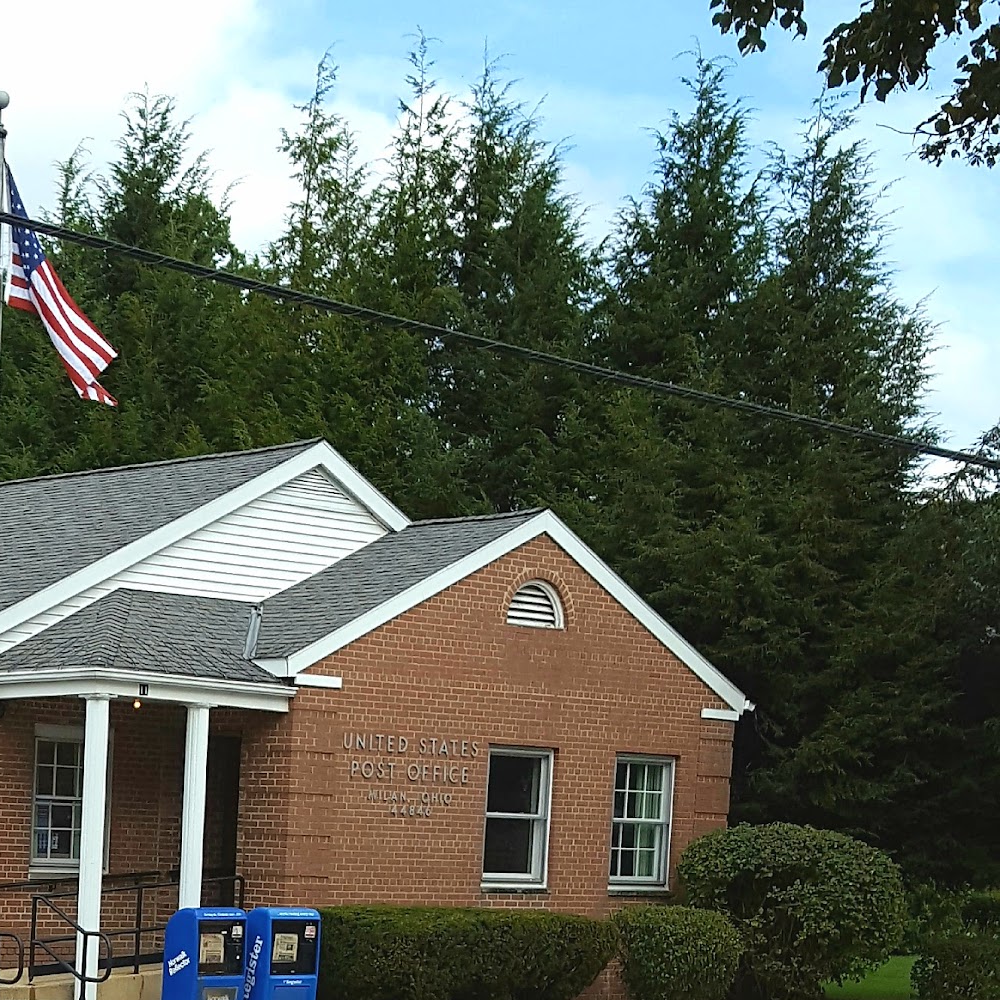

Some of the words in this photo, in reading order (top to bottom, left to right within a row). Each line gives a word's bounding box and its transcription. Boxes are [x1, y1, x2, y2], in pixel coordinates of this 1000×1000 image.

[343, 731, 409, 753] UNITED
[419, 737, 480, 758] STATES
[350, 759, 396, 780] POST
[407, 763, 469, 784] OFFICE
[421, 791, 453, 805] OHIO
[390, 804, 433, 817] 44846
